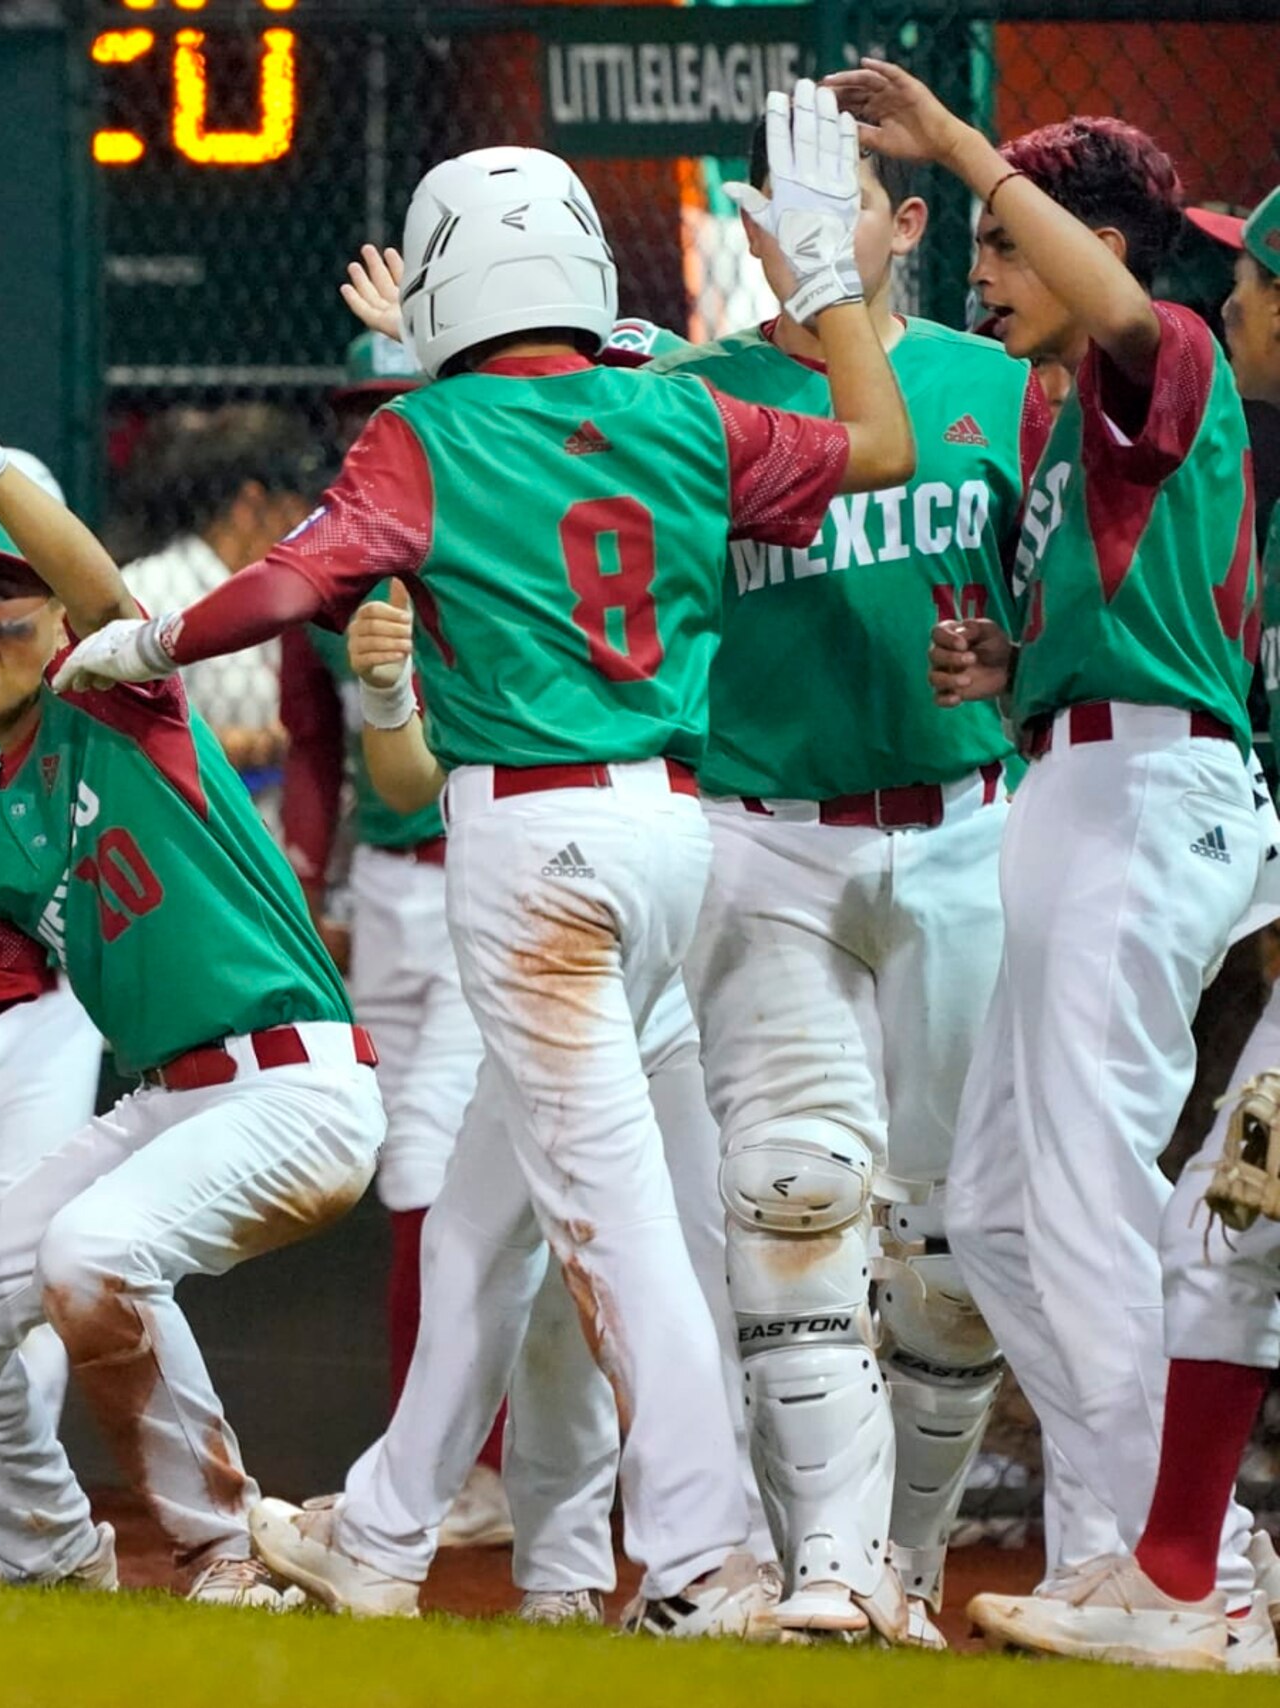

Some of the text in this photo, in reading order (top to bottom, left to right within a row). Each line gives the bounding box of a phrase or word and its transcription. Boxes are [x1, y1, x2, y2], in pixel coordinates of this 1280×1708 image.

[729, 479, 989, 597] MEXICO
[558, 494, 665, 683] 8
[541, 864, 596, 880] adidas
[739, 1318, 851, 1343] EASTON
